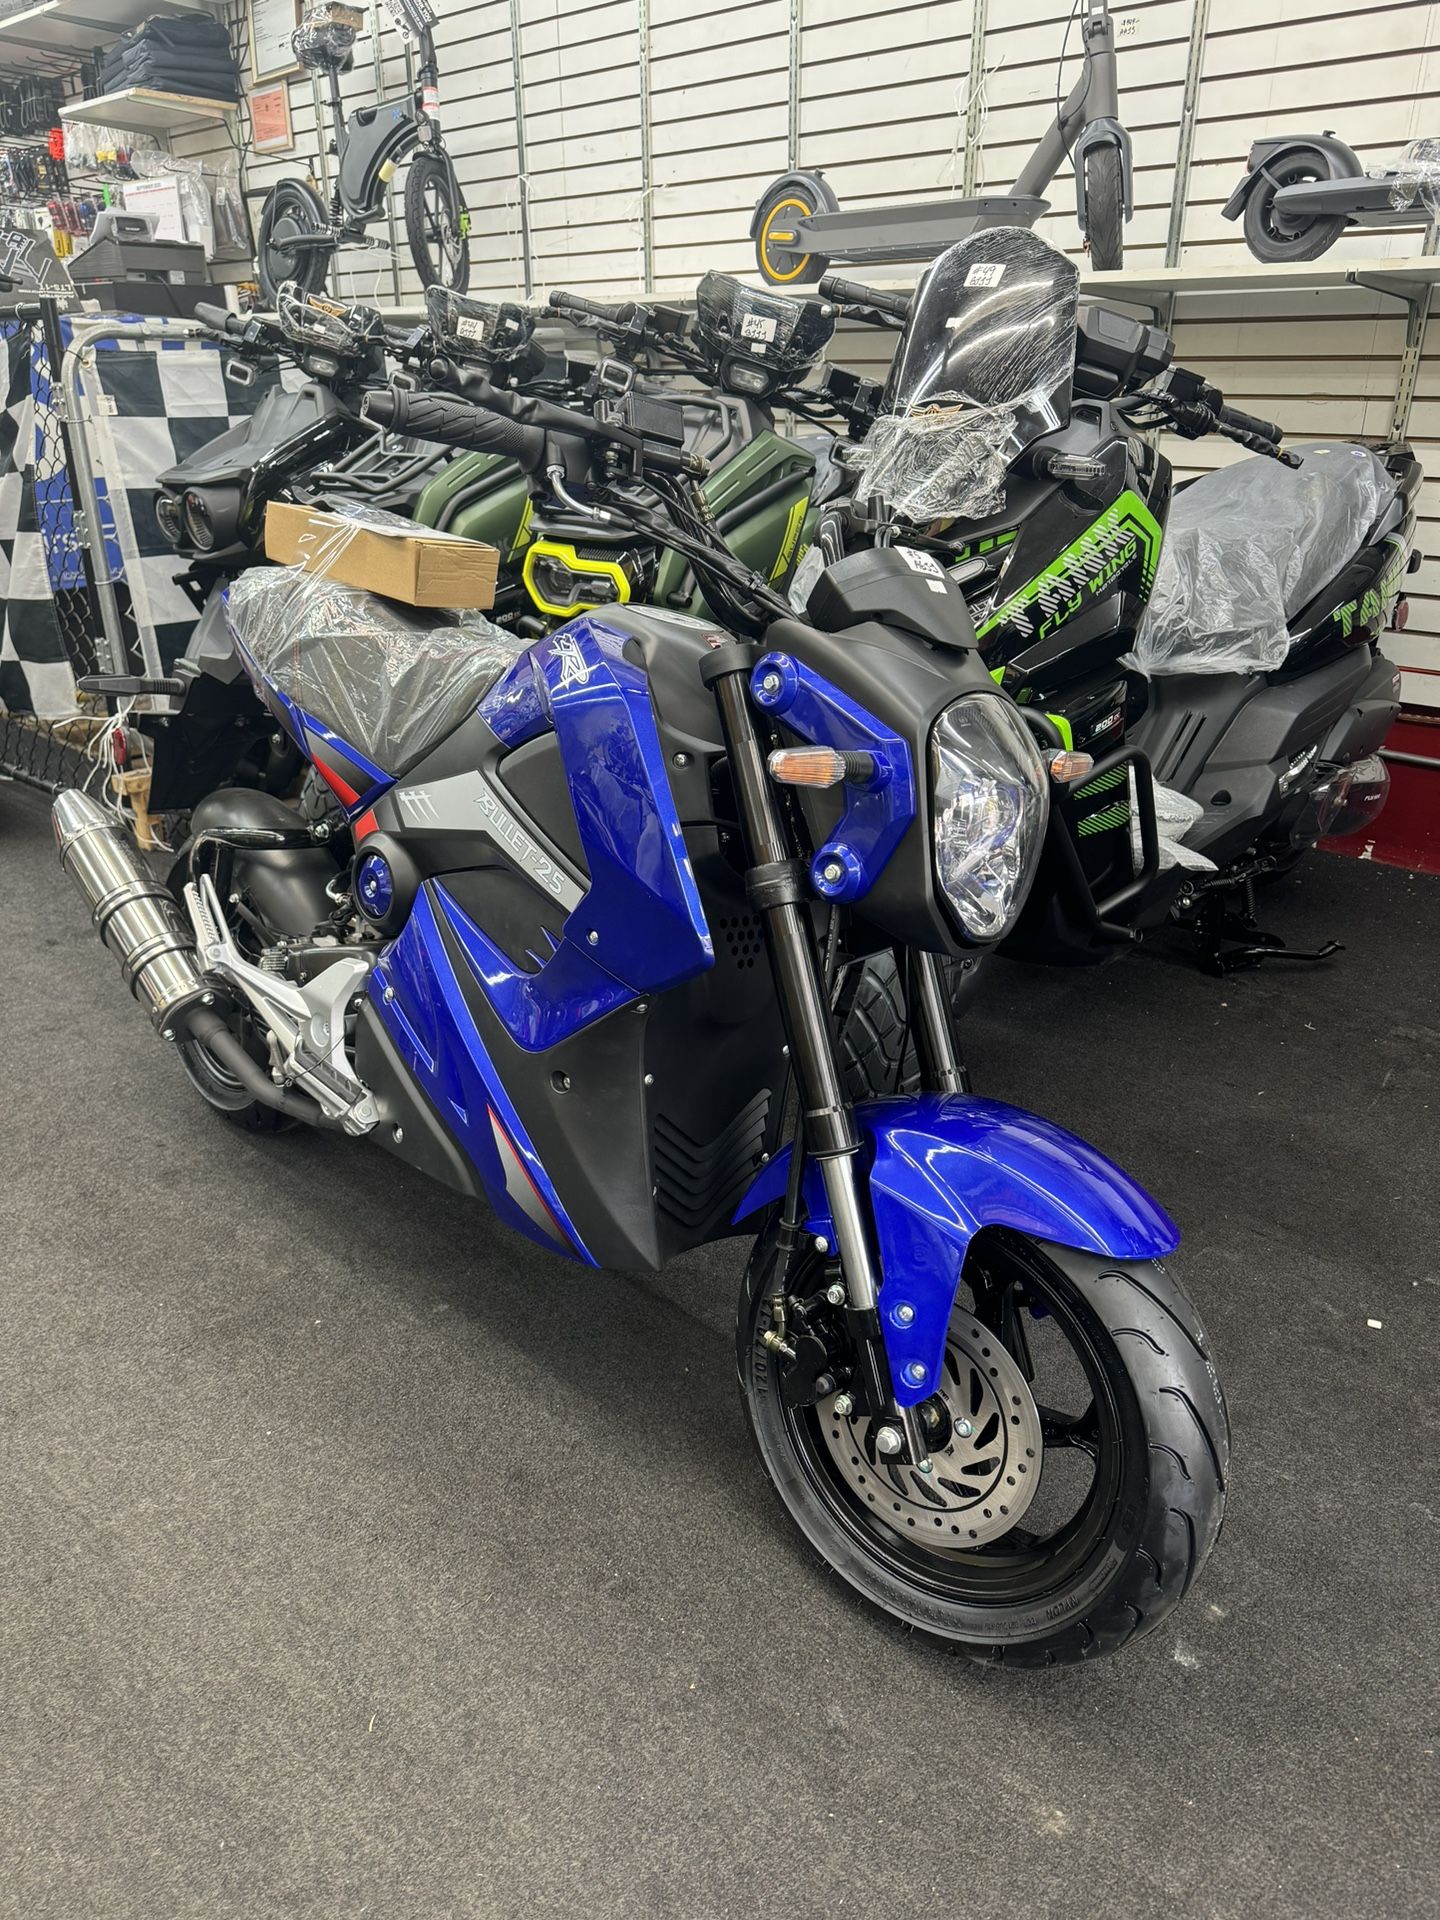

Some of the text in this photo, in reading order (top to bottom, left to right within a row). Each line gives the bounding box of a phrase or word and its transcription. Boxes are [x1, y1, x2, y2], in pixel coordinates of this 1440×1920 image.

[1088, 540, 1137, 593] WING
[1094, 714, 1114, 733] 200
[473, 788, 566, 895] BULLET-25
